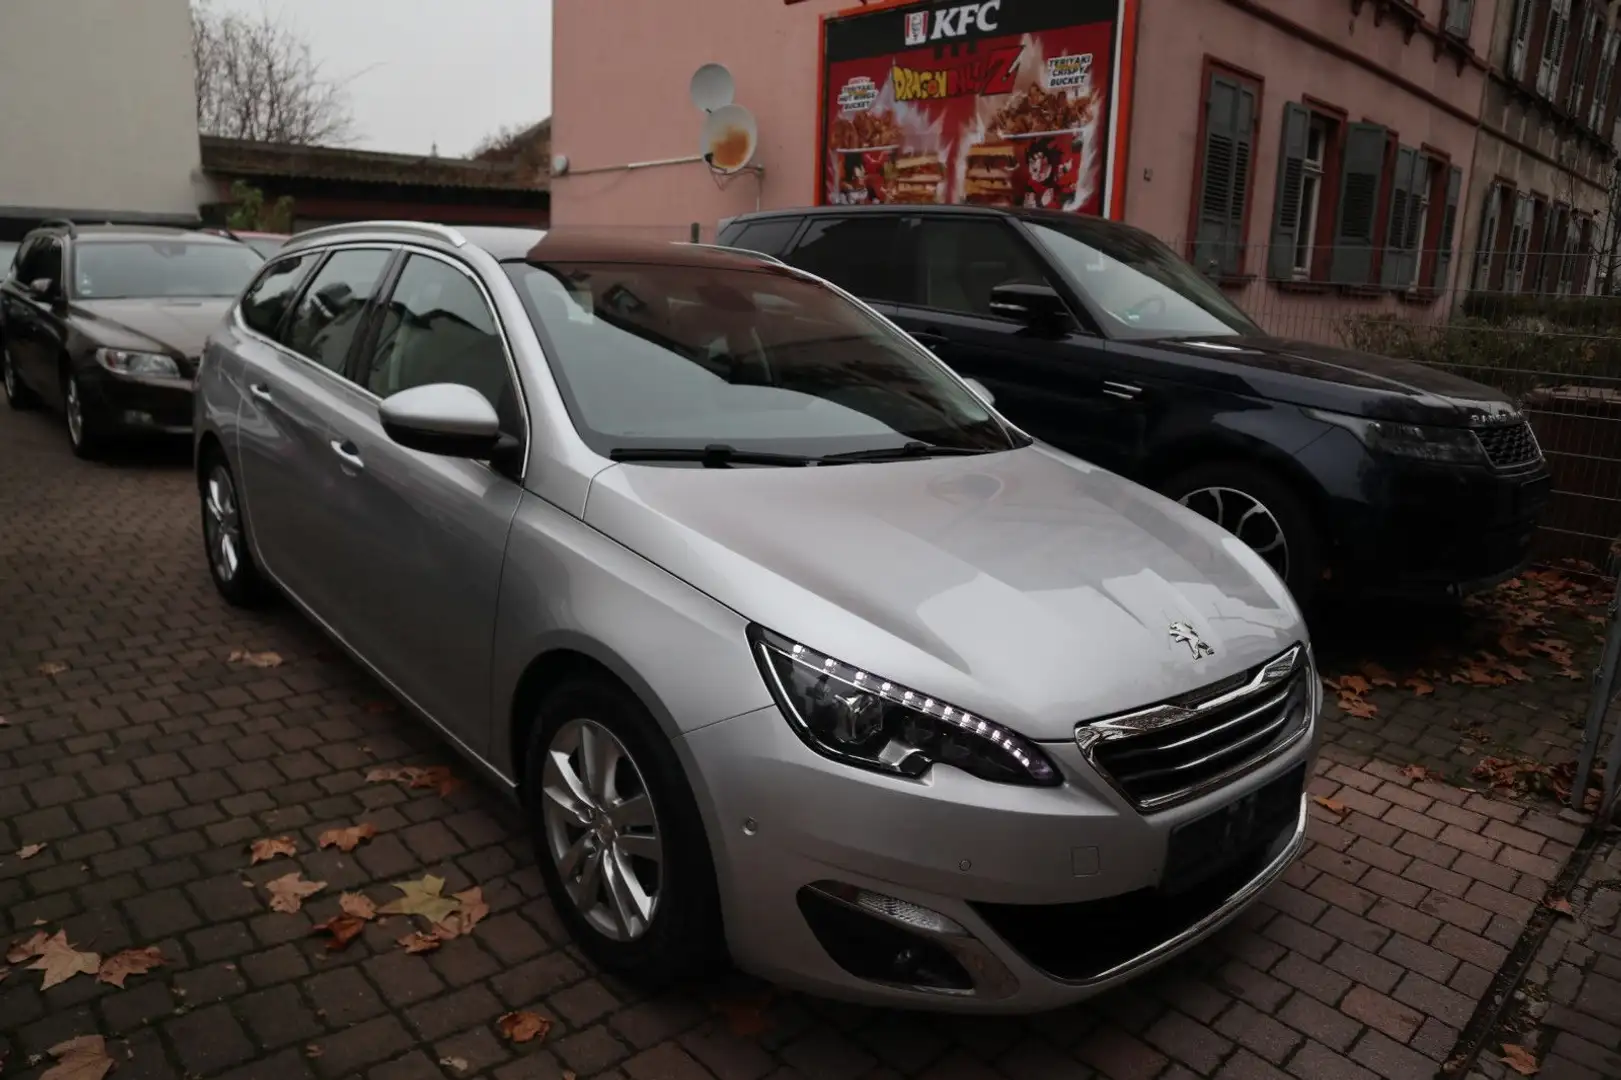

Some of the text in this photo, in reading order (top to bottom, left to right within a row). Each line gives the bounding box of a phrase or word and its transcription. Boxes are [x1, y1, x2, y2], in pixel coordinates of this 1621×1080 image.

[930, 0, 1000, 40] KFC
[892, 65, 947, 100] DRAGON
[980, 45, 1026, 97] Z
[1049, 55, 1091, 67] TERIYAKI
[1049, 75, 1085, 87] BUCKET
